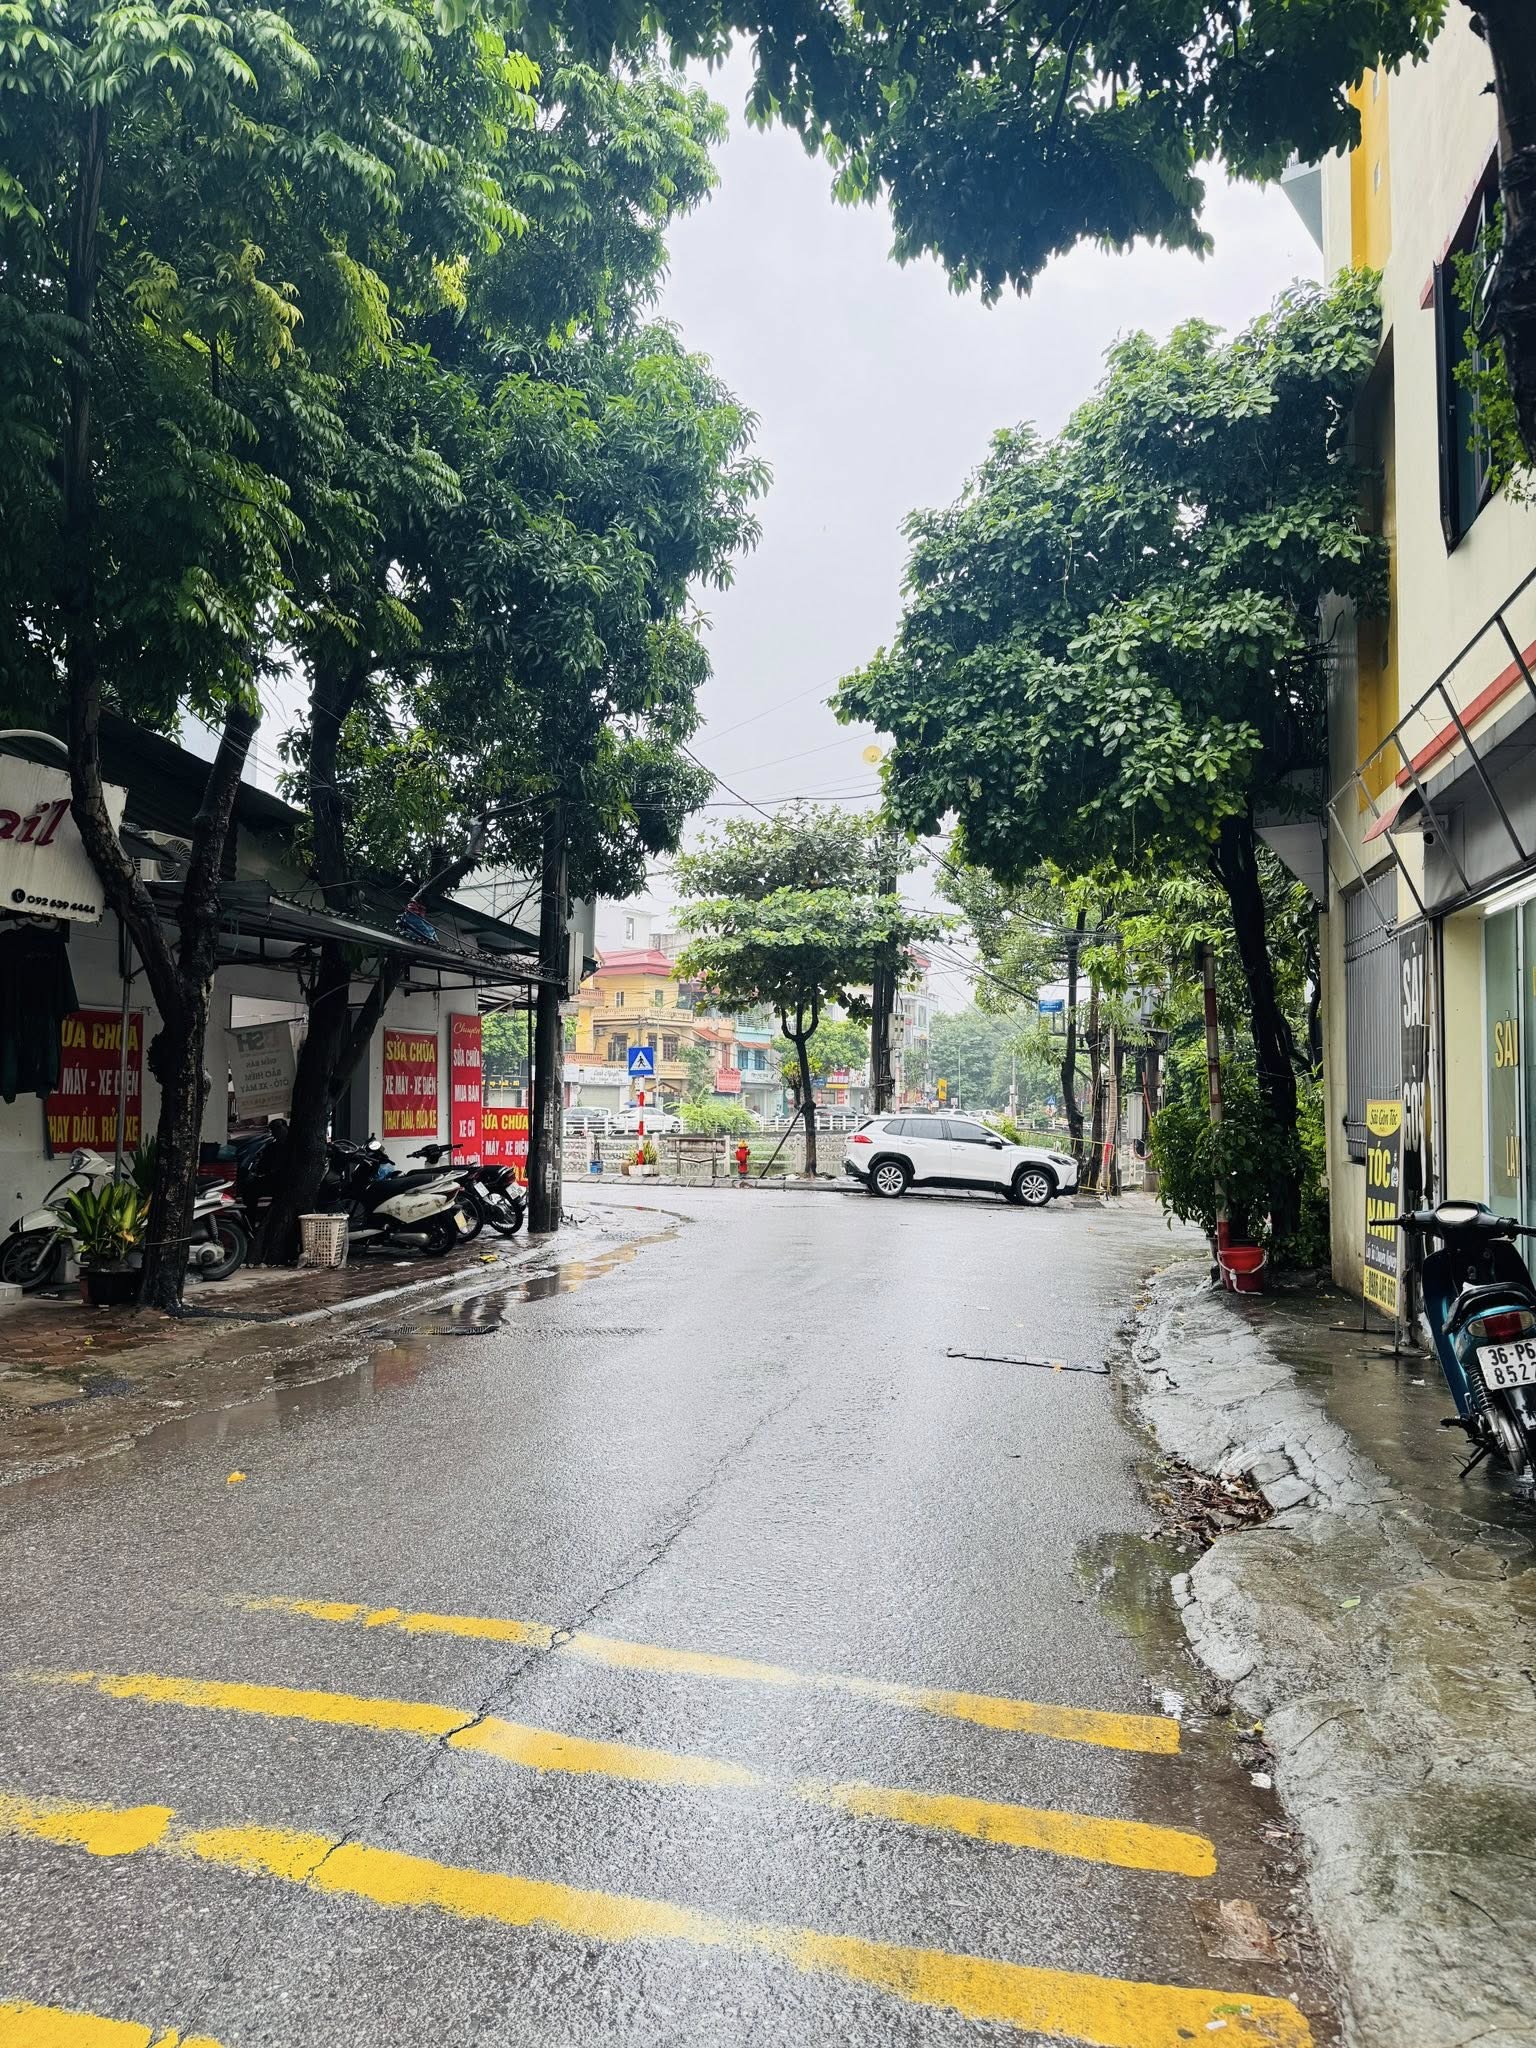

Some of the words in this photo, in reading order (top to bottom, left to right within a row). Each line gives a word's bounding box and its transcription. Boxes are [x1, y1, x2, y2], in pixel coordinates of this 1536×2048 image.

[27, 895, 48, 906] 092
[50, 899, 69, 910] 639
[1403, 941, 1423, 1028] SÀI
[386, 1035, 407, 1061] SỬA
[409, 1040, 436, 1063] CHỮA
[1494, 1009, 1519, 1068] SÀI
[62, 1062, 88, 1095] MÁY
[98, 1069, 113, 1096] XE
[385, 1074, 394, 1095] XE
[395, 1071, 409, 1096] MÁY
[413, 1076, 422, 1096] XE
[125, 1115, 139, 1142] XE
[384, 1110, 400, 1130] THAY
[429, 1109, 437, 1129] XE
[459, 1119, 467, 1138] XE
[501, 1111, 529, 1130] CHỮA
[485, 1137, 500, 1156] MÁY
[505, 1140, 513, 1156] XE
[1367, 1140, 1391, 1189] TÓC
[1367, 1197, 1396, 1242] NAM
[1488, 1343, 1536, 1365] 36-P6
